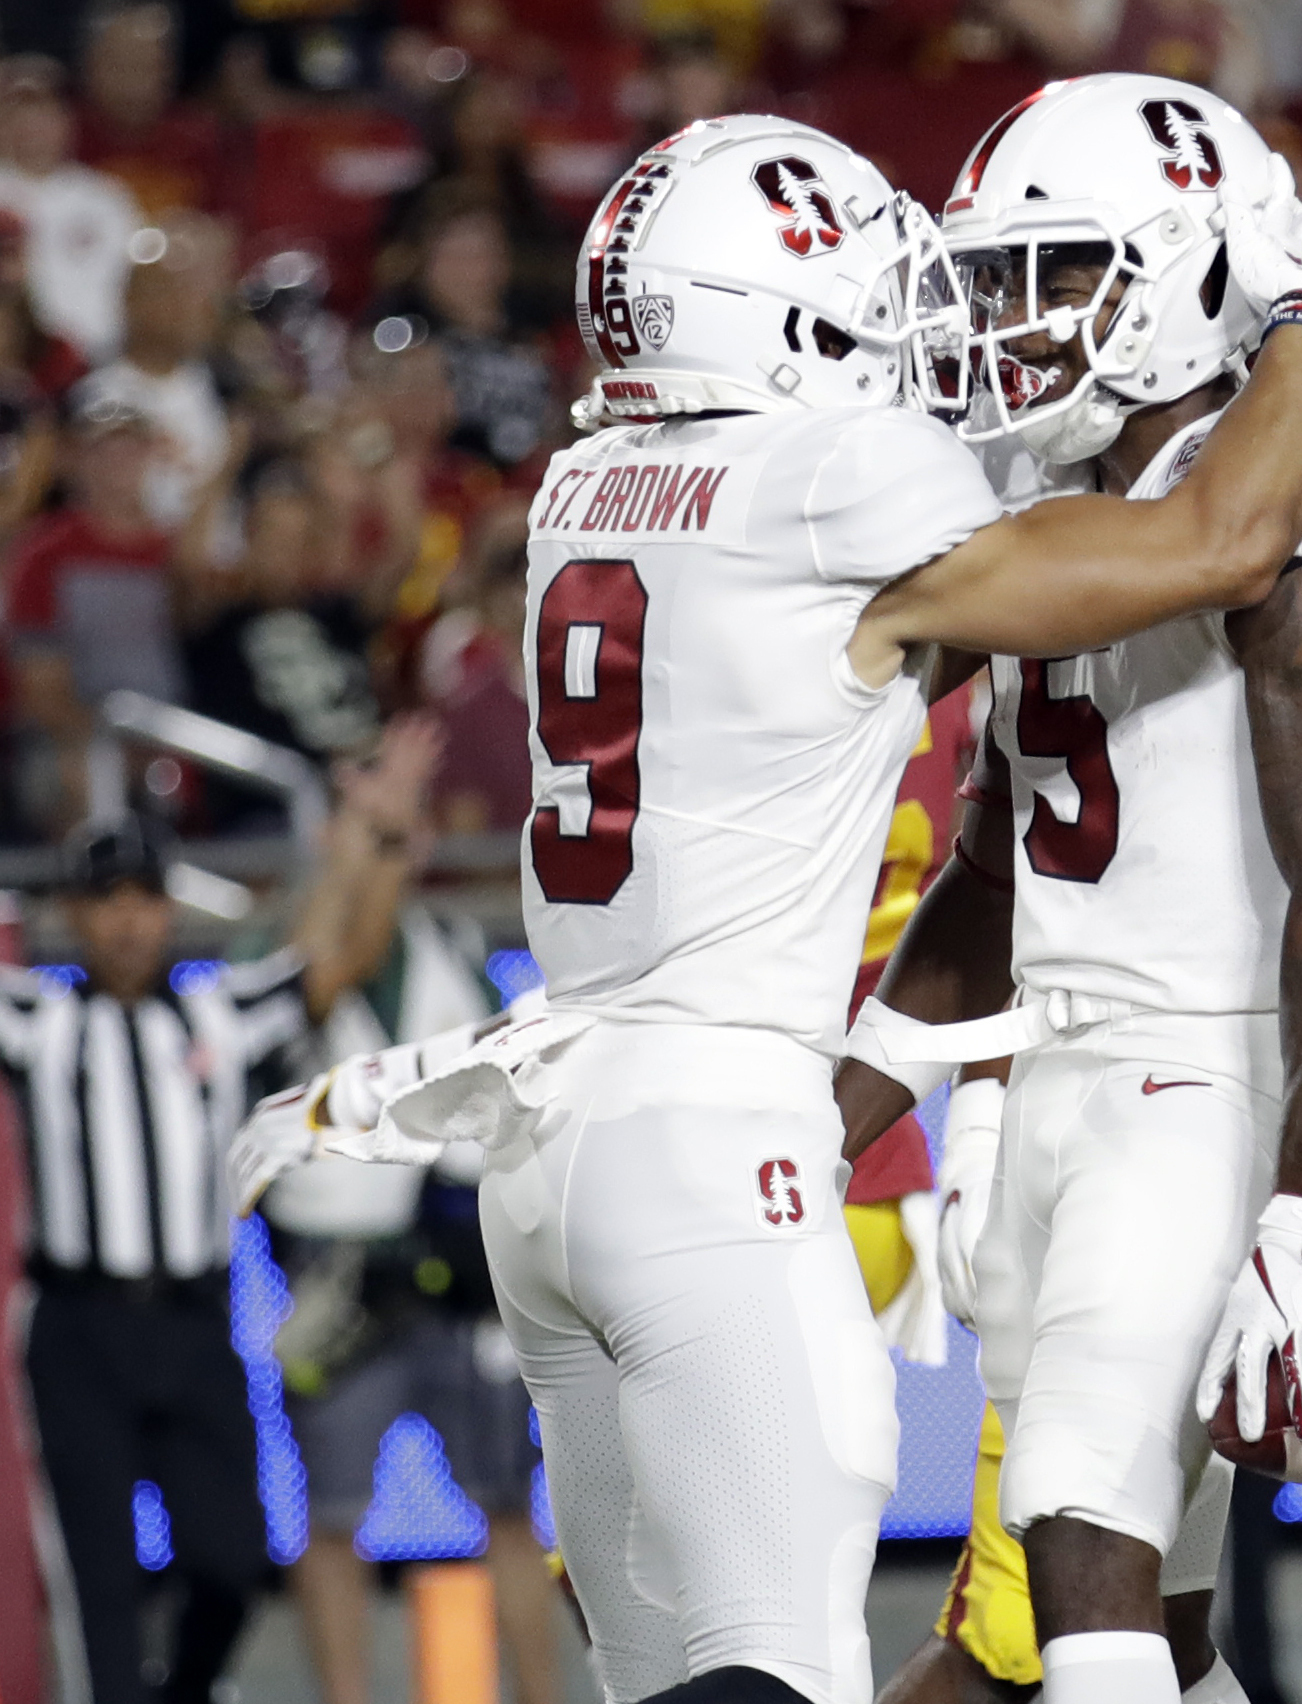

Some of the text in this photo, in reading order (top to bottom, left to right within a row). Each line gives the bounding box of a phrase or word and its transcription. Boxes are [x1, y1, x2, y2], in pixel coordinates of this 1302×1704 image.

[606, 298, 641, 356] 9
[648, 325, 663, 339] 12
[1275, 312, 1295, 321] THE
[537, 464, 729, 531] ST. BROWN
[531, 558, 649, 906] 9
[1017, 657, 1120, 884] 5
